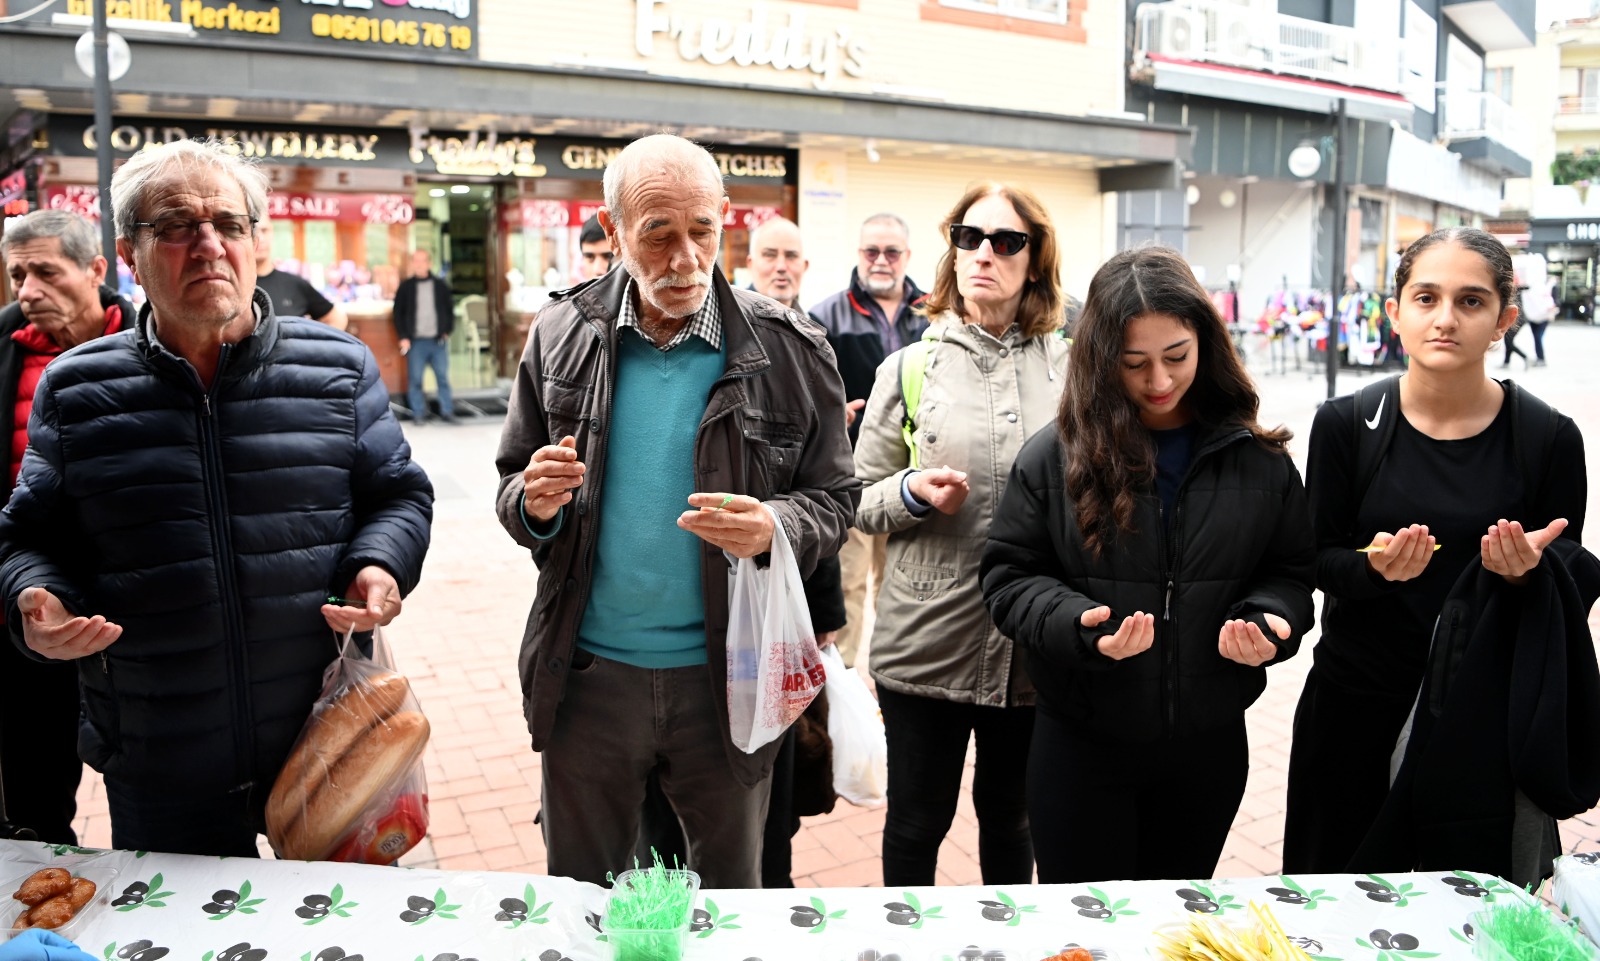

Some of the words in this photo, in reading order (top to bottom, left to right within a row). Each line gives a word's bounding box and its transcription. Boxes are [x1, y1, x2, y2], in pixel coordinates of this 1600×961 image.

[181, 0, 280, 34] Merkezi
[421, 22, 447, 47] 76
[448, 25, 472, 50] 19
[634, 0, 868, 91] Freddy's
[290, 196, 340, 217] SALE
